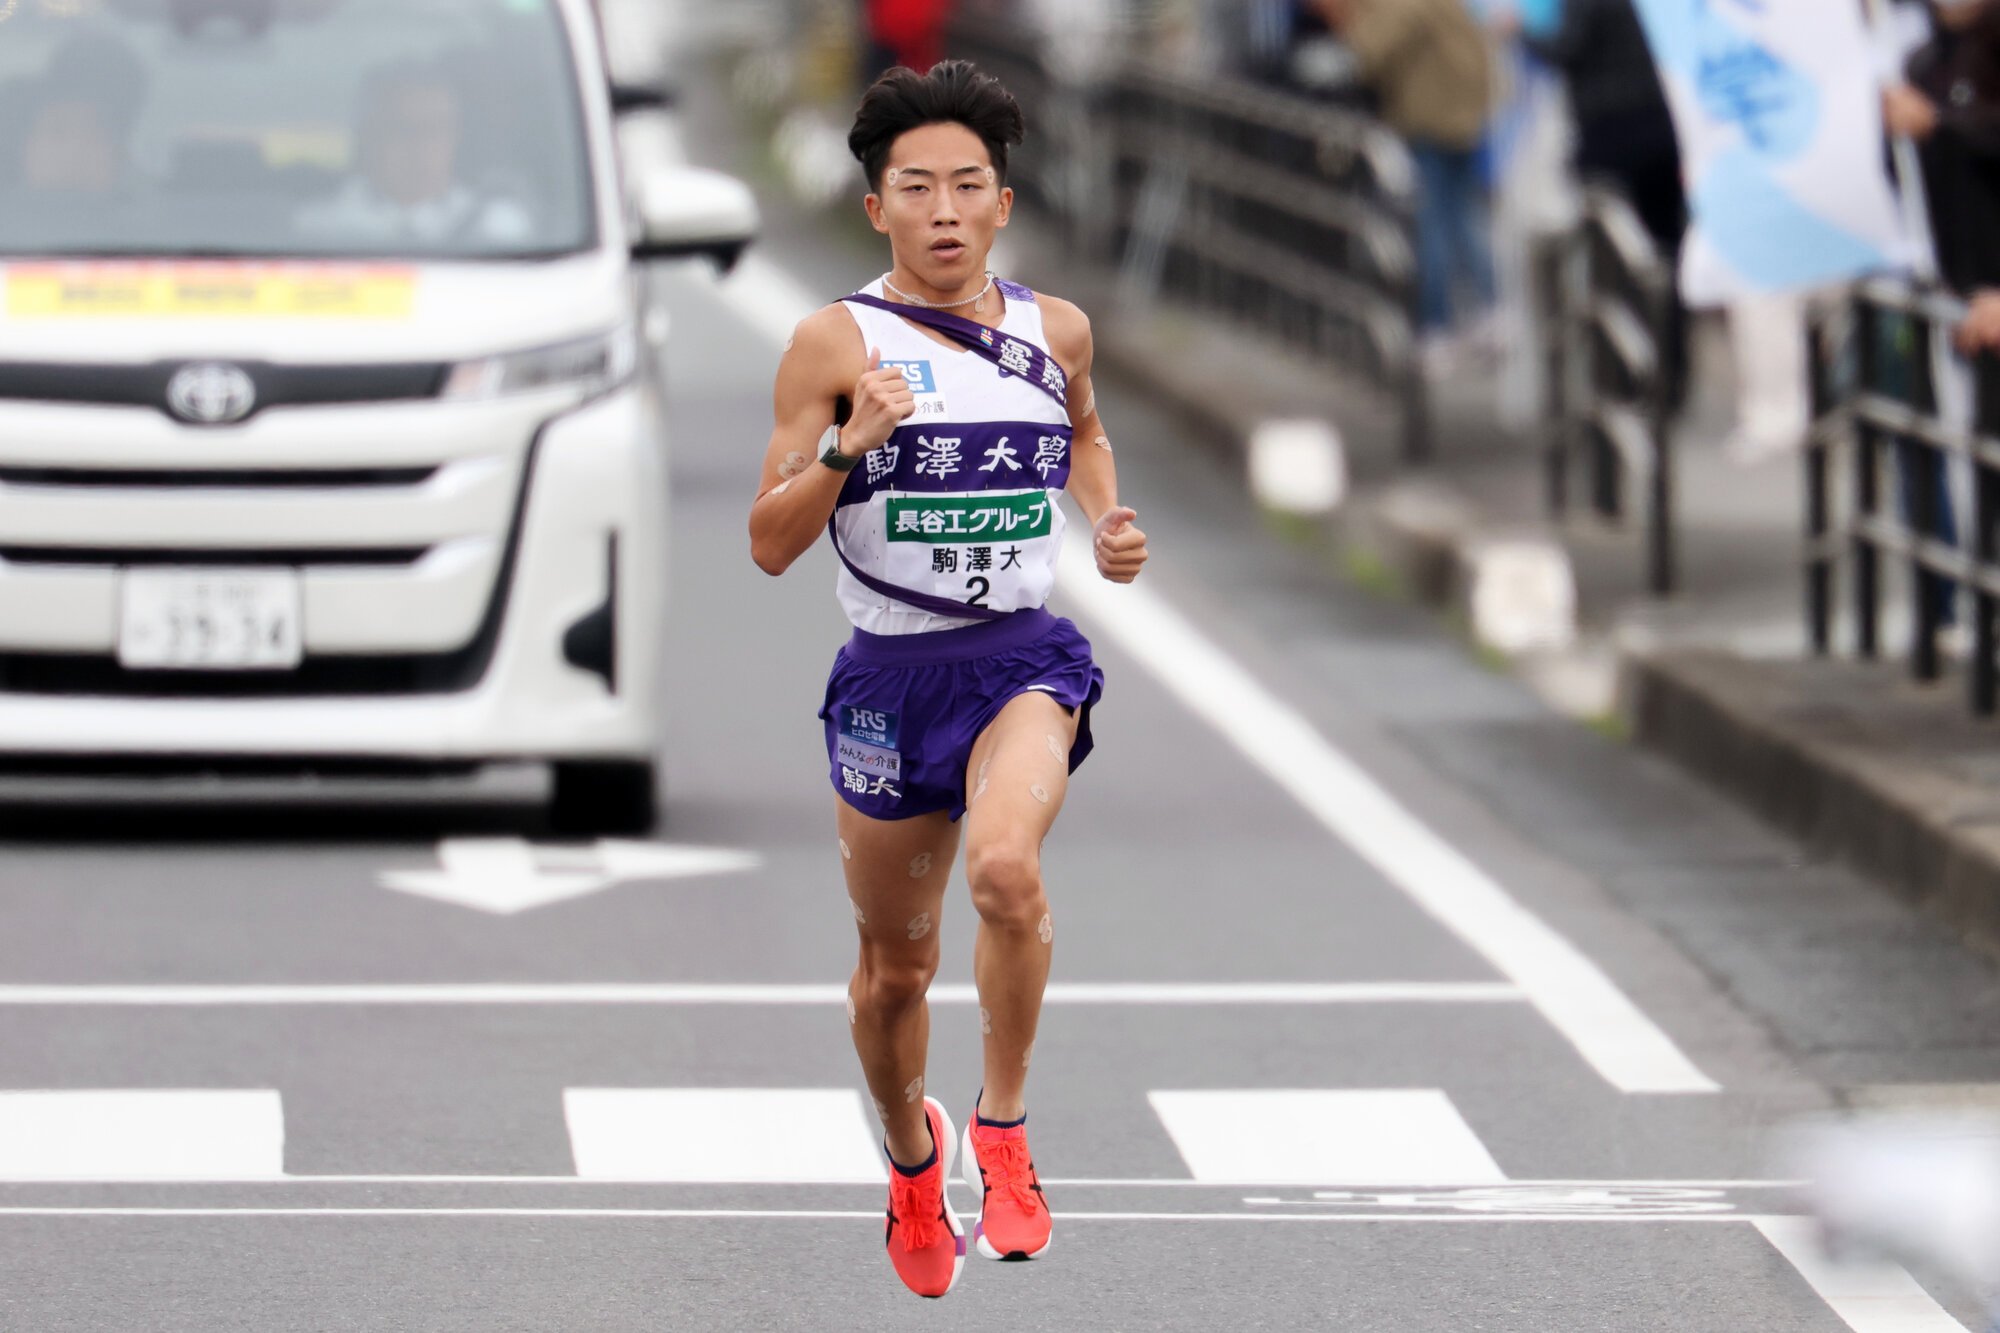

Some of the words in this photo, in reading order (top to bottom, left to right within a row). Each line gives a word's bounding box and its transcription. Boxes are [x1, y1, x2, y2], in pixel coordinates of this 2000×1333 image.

[882, 363, 923, 382] RS
[916, 401, 945, 414] 介護
[865, 435, 1067, 484] 駒澤大學
[895, 501, 1048, 534] 長谷工グループ
[932, 545, 1022, 573] 駒澤大
[965, 576, 990, 610] 2
[850, 708, 887, 731] HRS
[851, 728, 886, 743] ヒロセ電機
[839, 743, 898, 771] みんなの介護
[842, 766, 902, 798] 駒大
